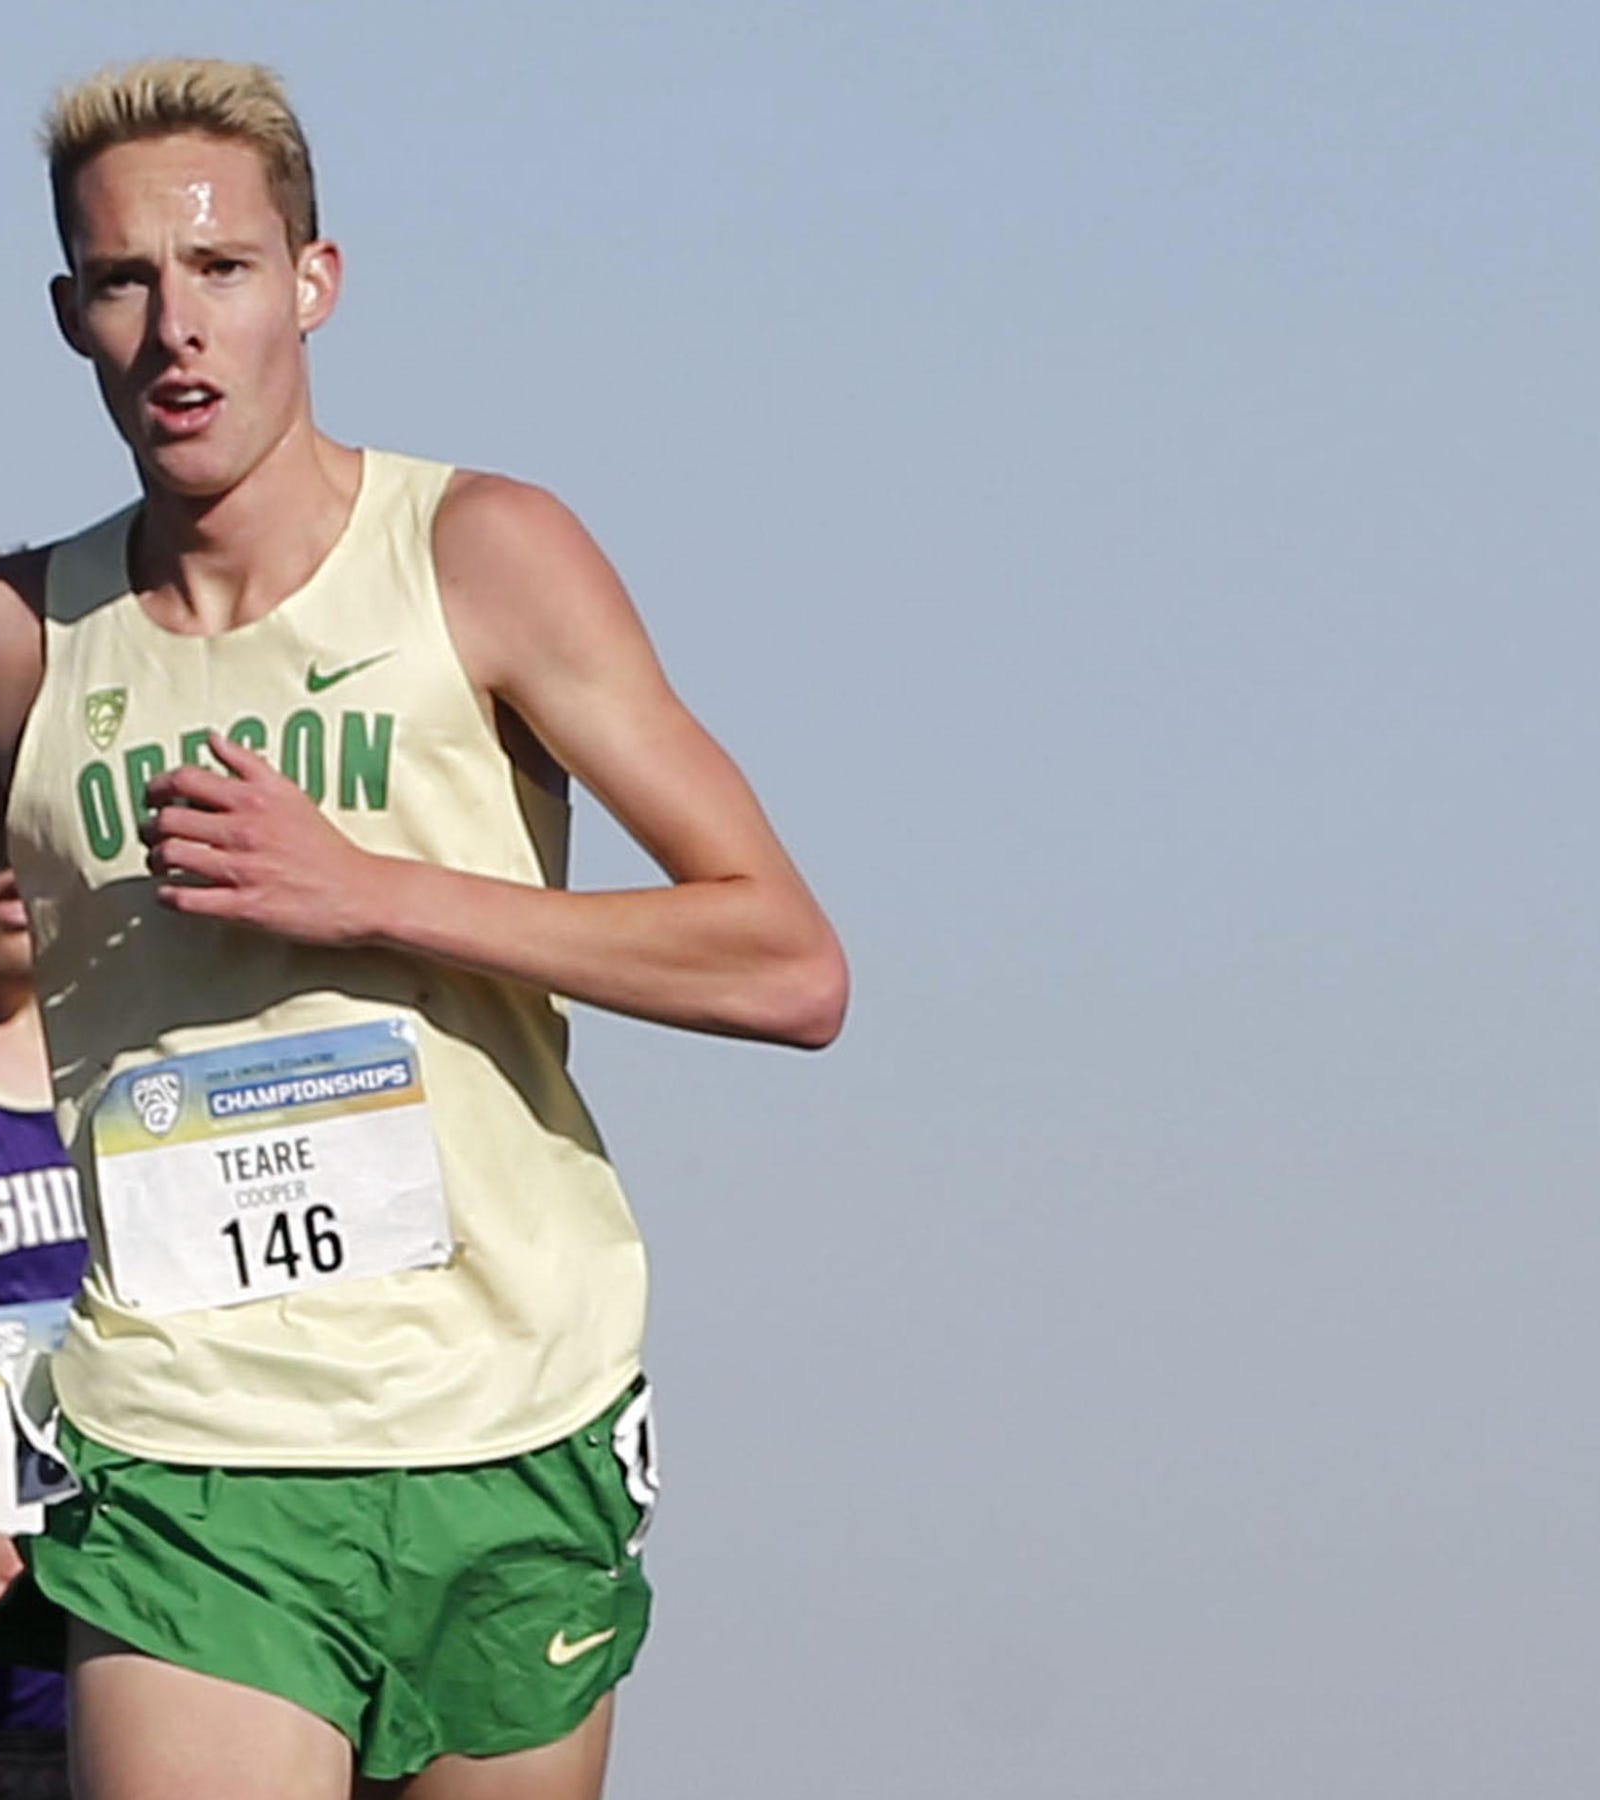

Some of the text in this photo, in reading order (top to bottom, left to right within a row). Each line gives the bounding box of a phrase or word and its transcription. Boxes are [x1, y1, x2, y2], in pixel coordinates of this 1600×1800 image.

[212, 1063, 408, 1115] CHAMPIONSHIPS
[216, 1137, 315, 1183] TEARE
[235, 1180, 309, 1209] COOPER
[220, 1203, 343, 1288] 146
